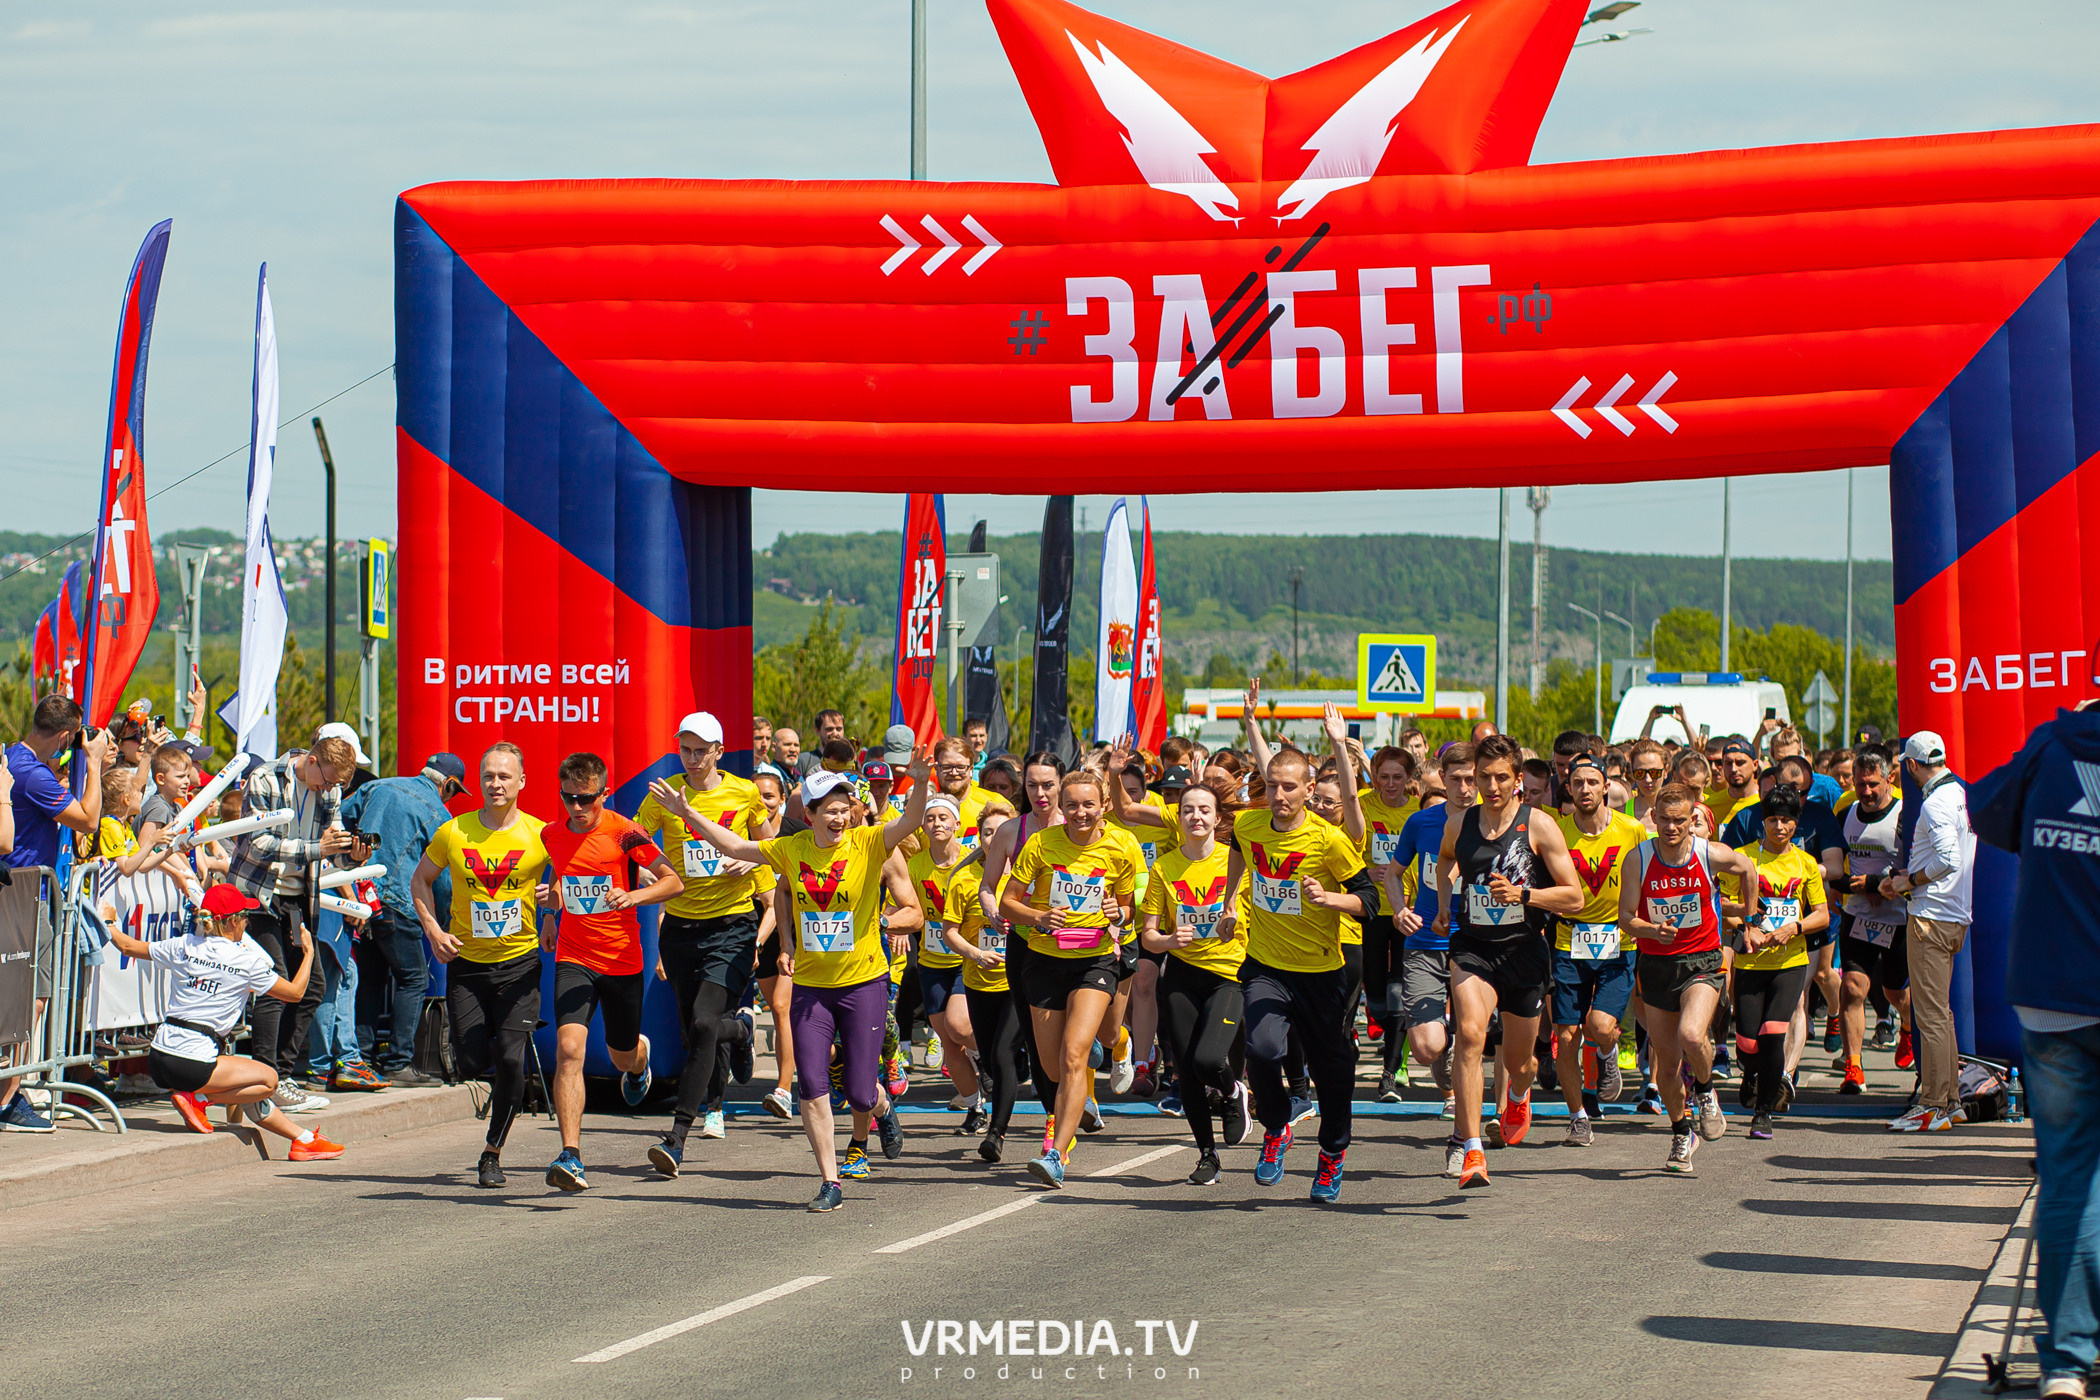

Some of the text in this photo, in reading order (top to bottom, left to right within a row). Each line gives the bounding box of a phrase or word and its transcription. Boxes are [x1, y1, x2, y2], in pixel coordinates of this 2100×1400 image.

[424, 658, 629, 688] В ритме всей
[1929, 650, 2087, 693] ЗАБЕГ
[455, 696, 600, 723] СТРАНЫ!
[1849, 843, 1885, 852] RUNNING
[464, 857, 519, 870] ONE
[1252, 852, 1299, 875] ONE
[798, 868, 846, 884] ONE
[1590, 875, 1618, 888] UN
[465, 878, 519, 889] RUN
[1056, 881, 1101, 897] 10079
[1255, 881, 1298, 899] 10186
[1650, 877, 1701, 890] RUSSIA
[797, 890, 849, 905] RUN
[475, 907, 518, 921] 10159
[1652, 902, 1698, 915] 10068
[1765, 906, 1797, 916] 0183
[805, 921, 850, 933] 10175
[1859, 918, 1893, 934] 10870
[1576, 933, 1615, 943] 10171
